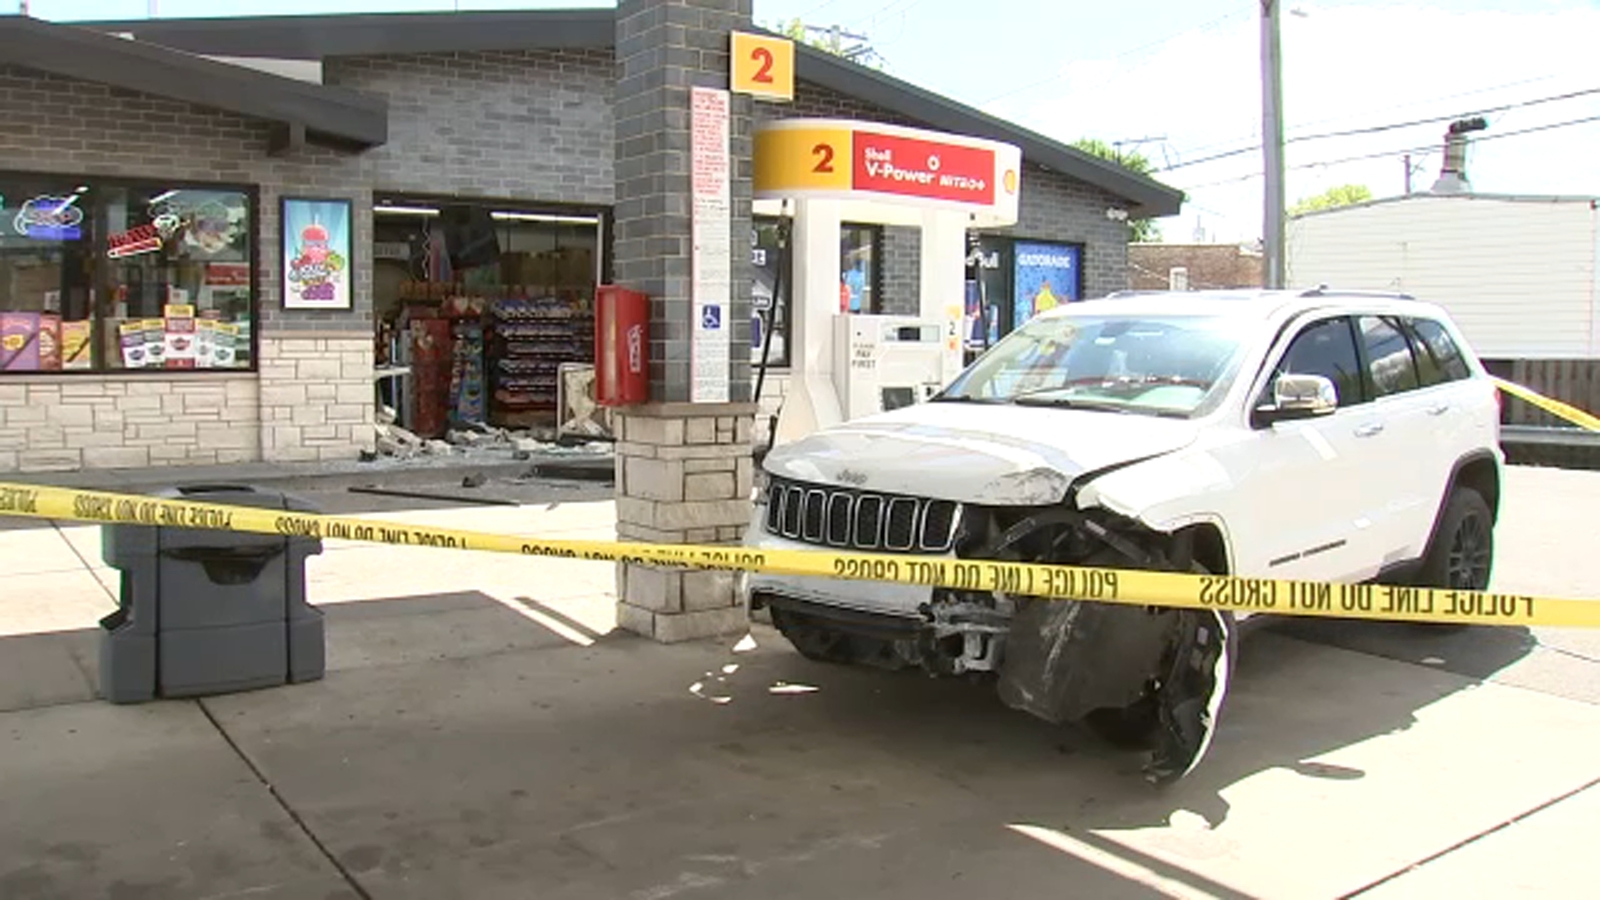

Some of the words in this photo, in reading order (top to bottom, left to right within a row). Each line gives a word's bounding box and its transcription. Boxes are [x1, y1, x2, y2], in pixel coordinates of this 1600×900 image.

[750, 46, 774, 84] 2
[811, 144, 835, 173] 2
[864, 147, 892, 161] Shell
[864, 160, 935, 185] V-Power
[1019, 253, 1071, 269] GATORADE
[949, 321, 956, 336] 2
[855, 349, 871, 358] PAY
[852, 359, 876, 368] FIRST
